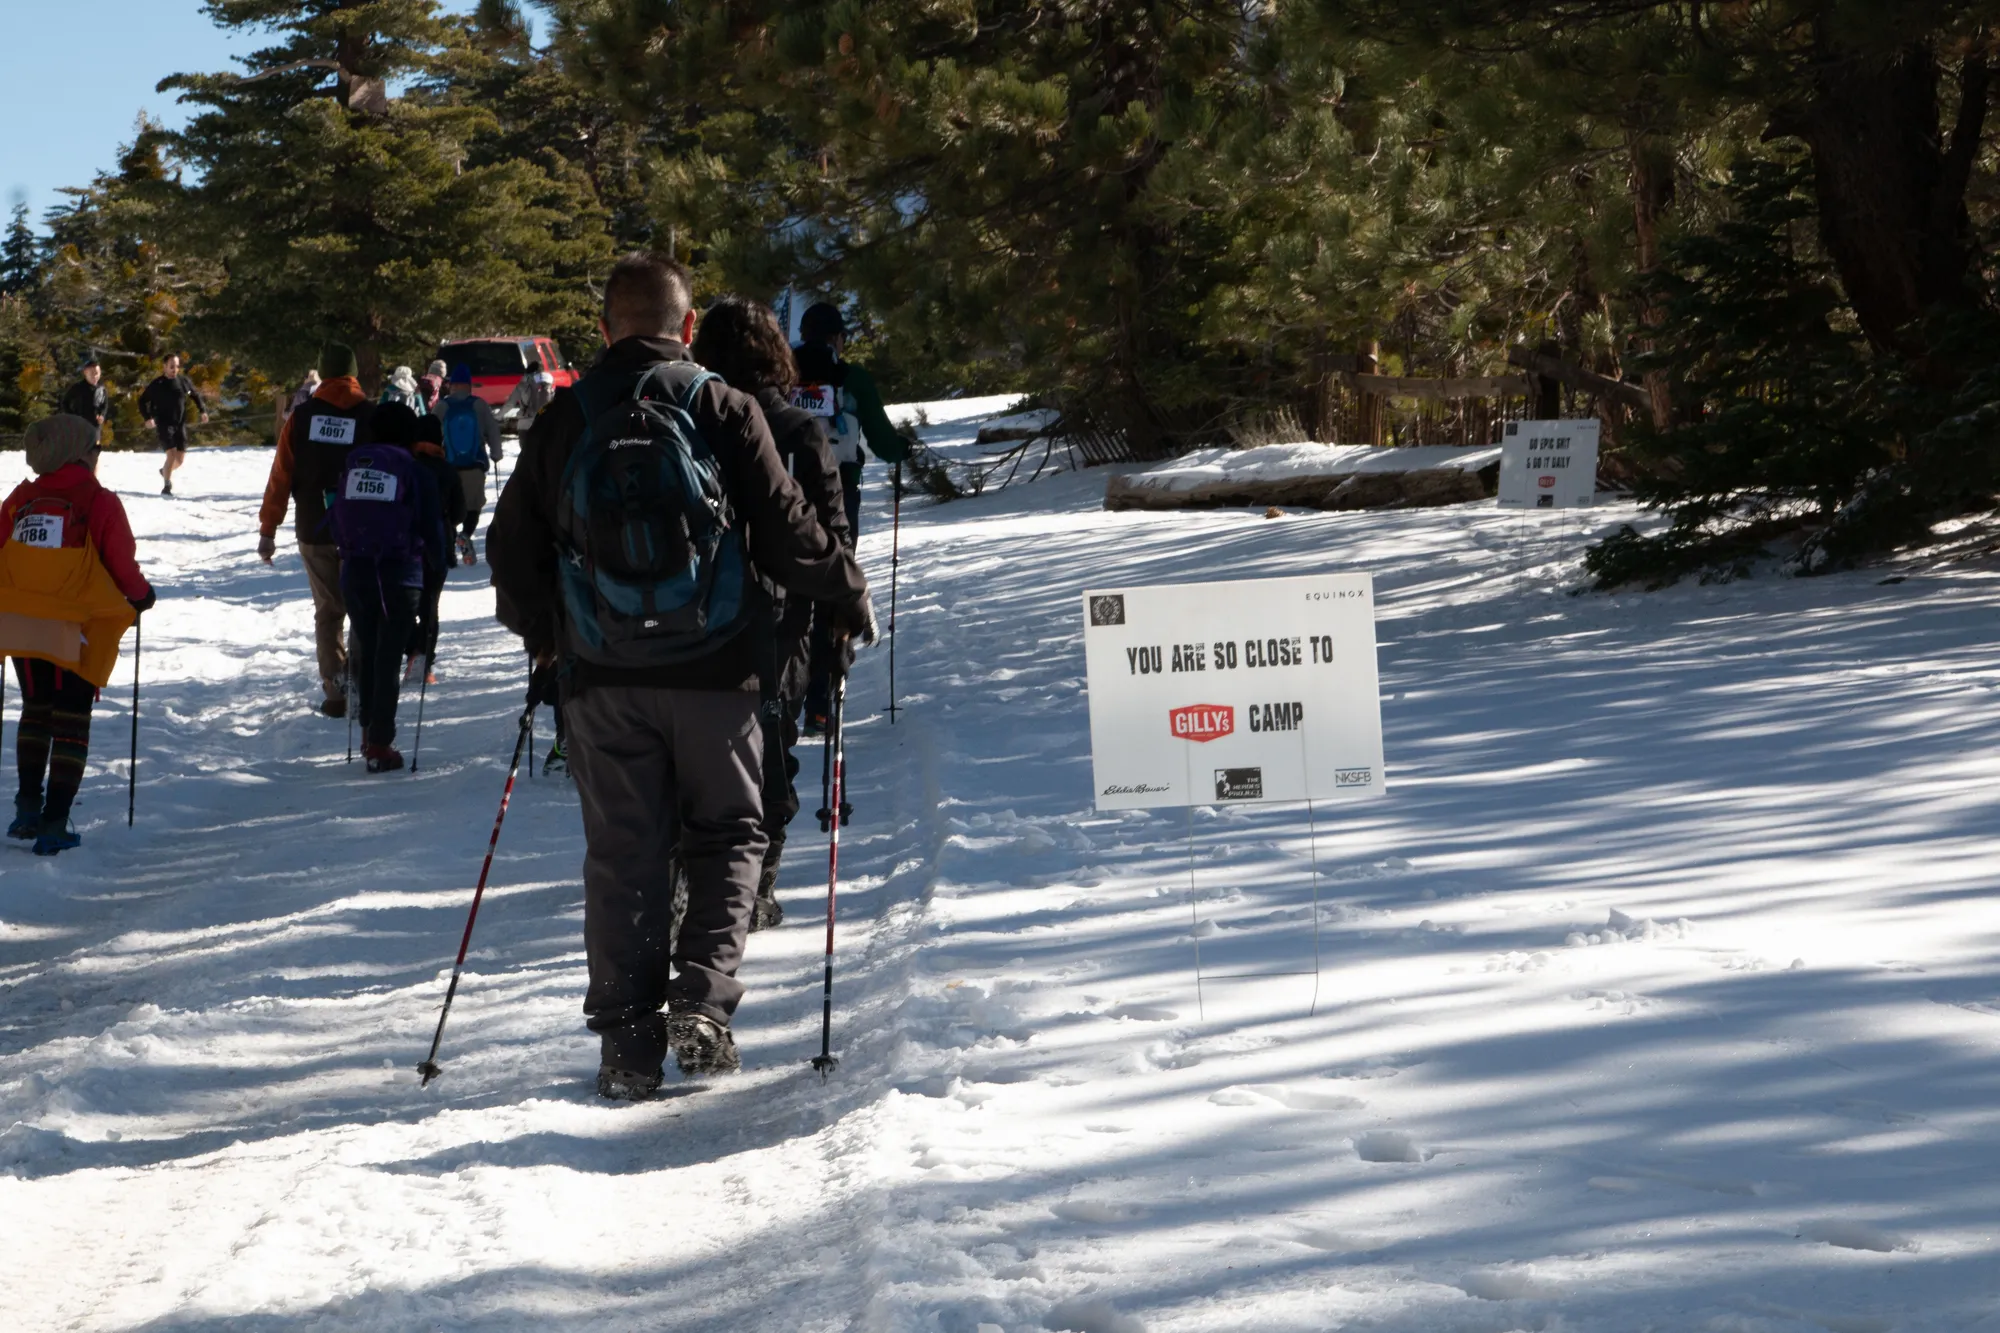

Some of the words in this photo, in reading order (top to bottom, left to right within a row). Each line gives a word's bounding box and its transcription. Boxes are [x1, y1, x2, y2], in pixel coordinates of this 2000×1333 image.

[319, 425, 346, 439] 4097
[356, 480, 385, 494] 4156
[1305, 589, 1365, 602] EQUINOX
[1126, 645, 1163, 675] YOU
[1171, 642, 1206, 673] ARE
[1213, 640, 1238, 670] SO
[1245, 636, 1302, 668] CLOSE
[1309, 635, 1334, 664] TO
[1248, 701, 1304, 733] CAMP
[1335, 771, 1372, 784] NKSFB
